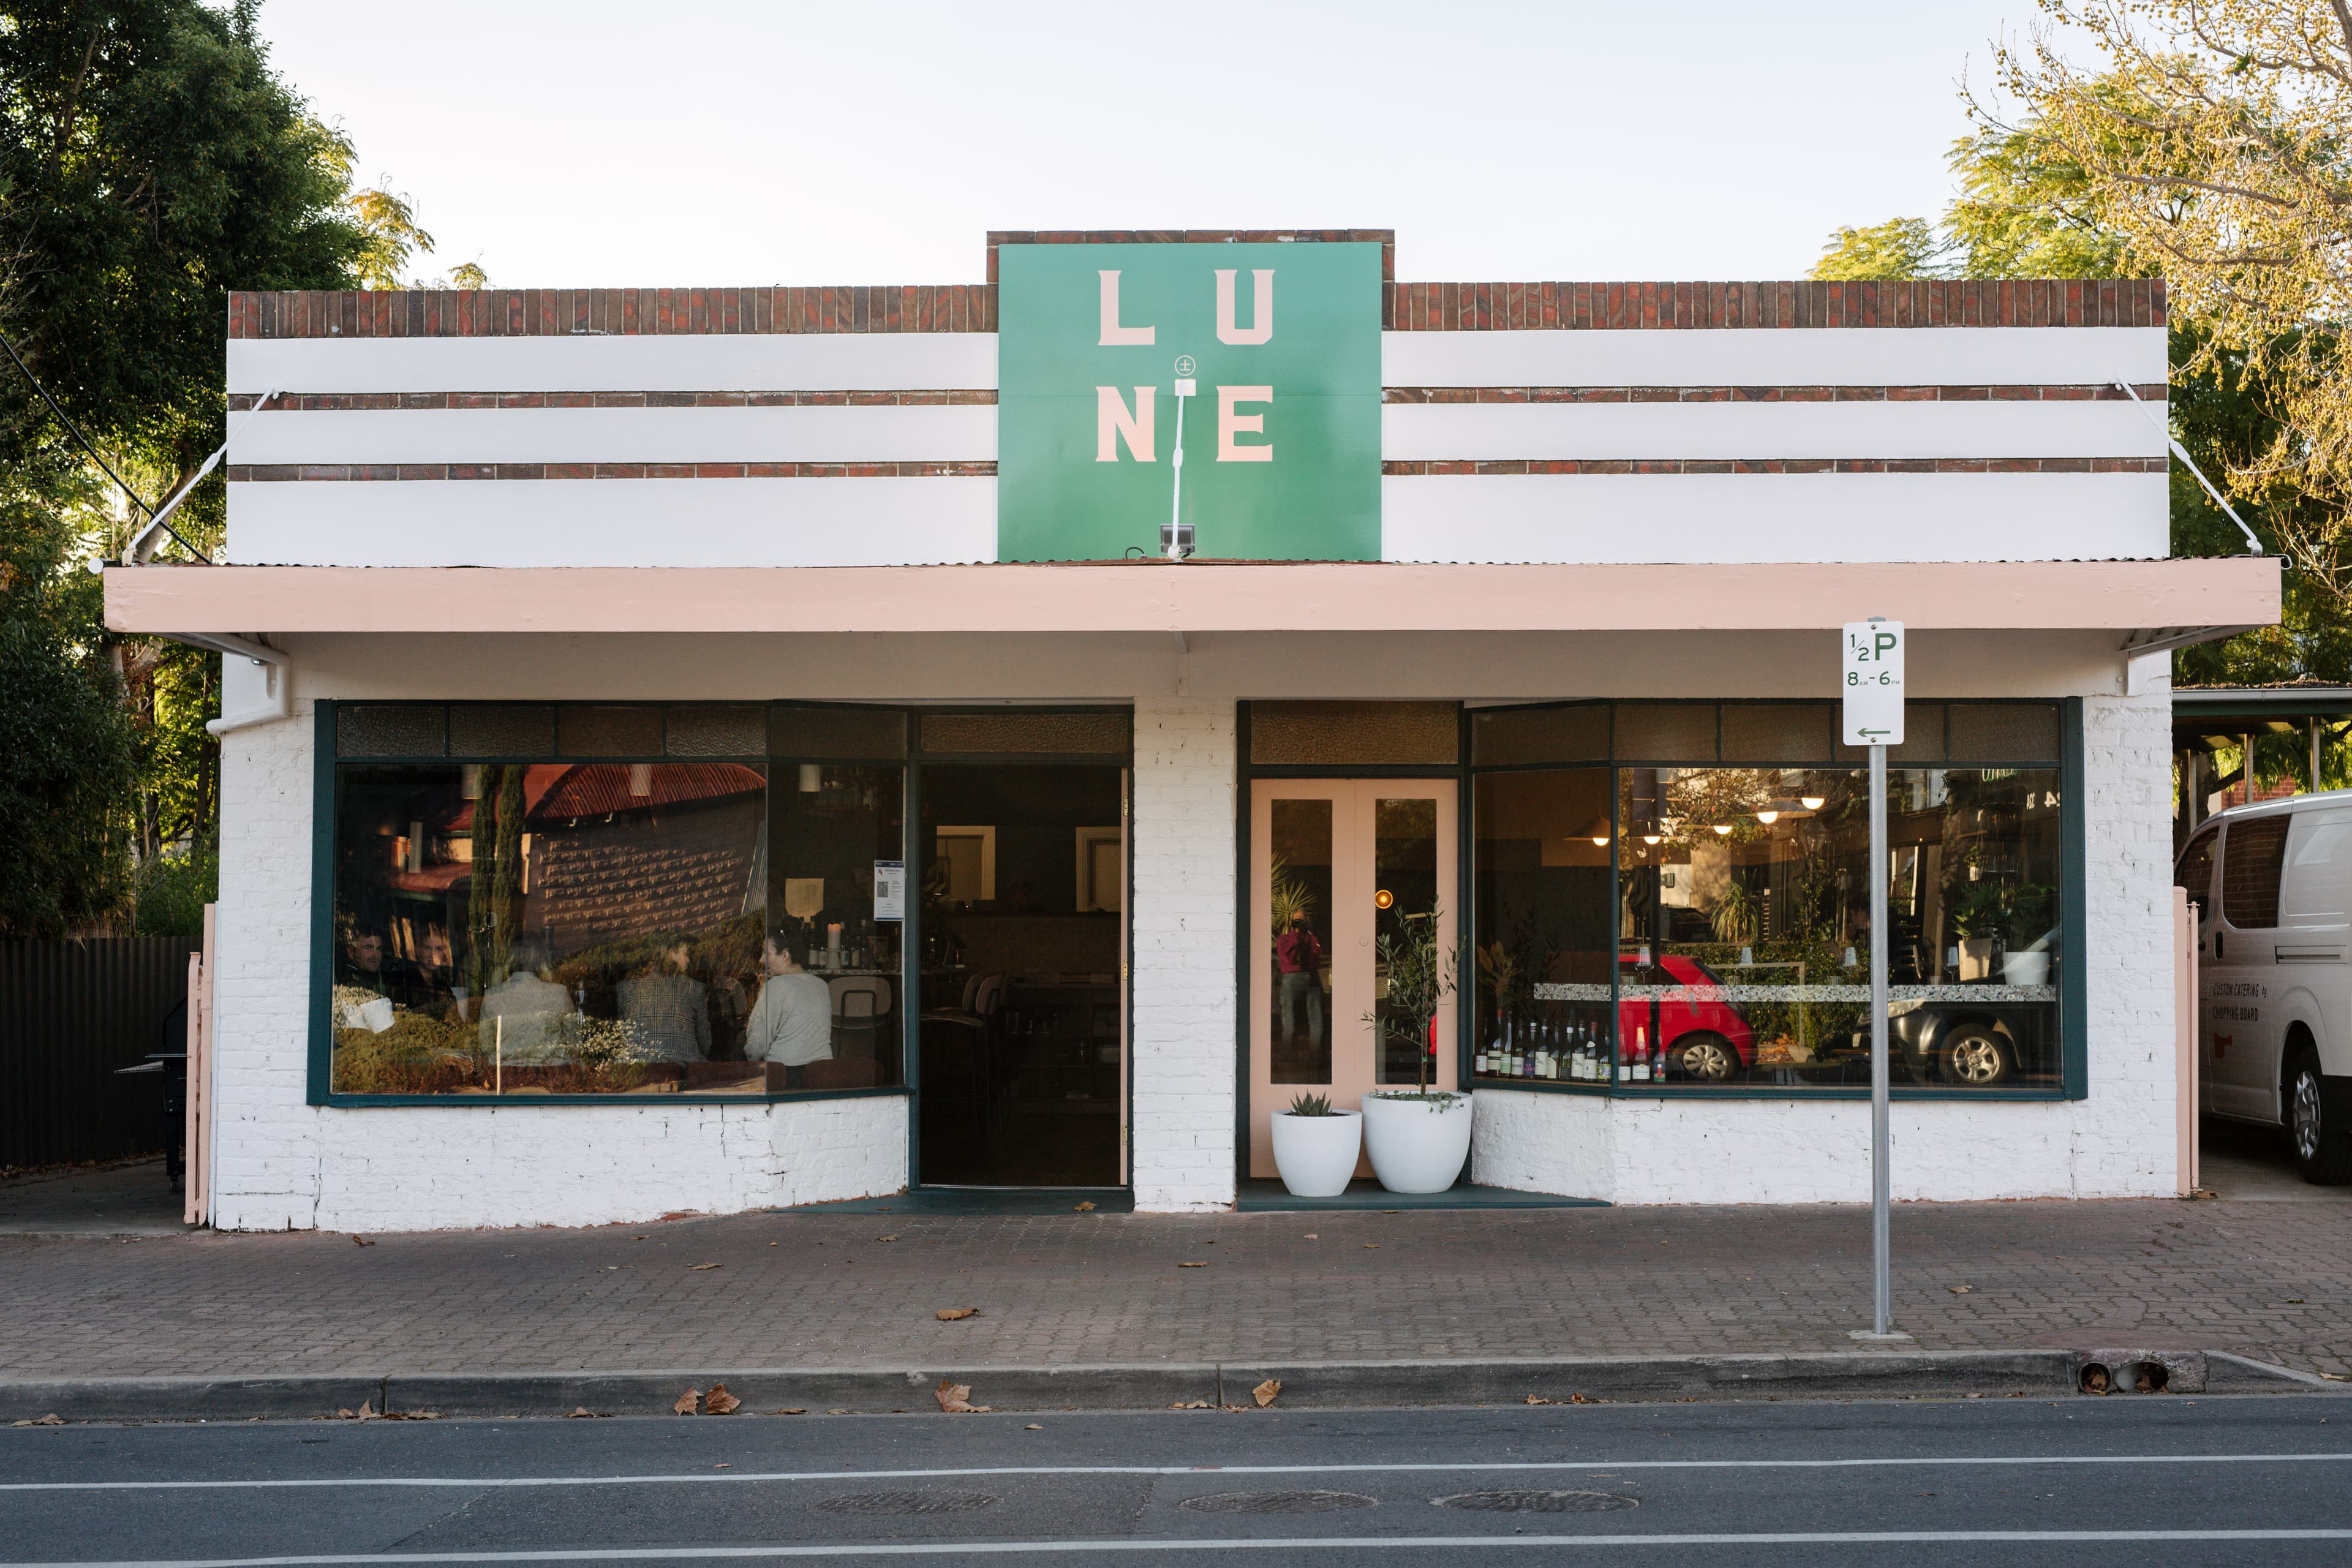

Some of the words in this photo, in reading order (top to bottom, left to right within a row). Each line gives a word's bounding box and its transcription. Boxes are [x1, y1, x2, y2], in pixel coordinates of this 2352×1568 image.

[2214, 982, 2233, 997] CUSTOM
[2234, 982, 2260, 998] CATERING
[2213, 1006, 2239, 1020] CHOPPING
[2240, 1007, 2258, 1022] BOARD
